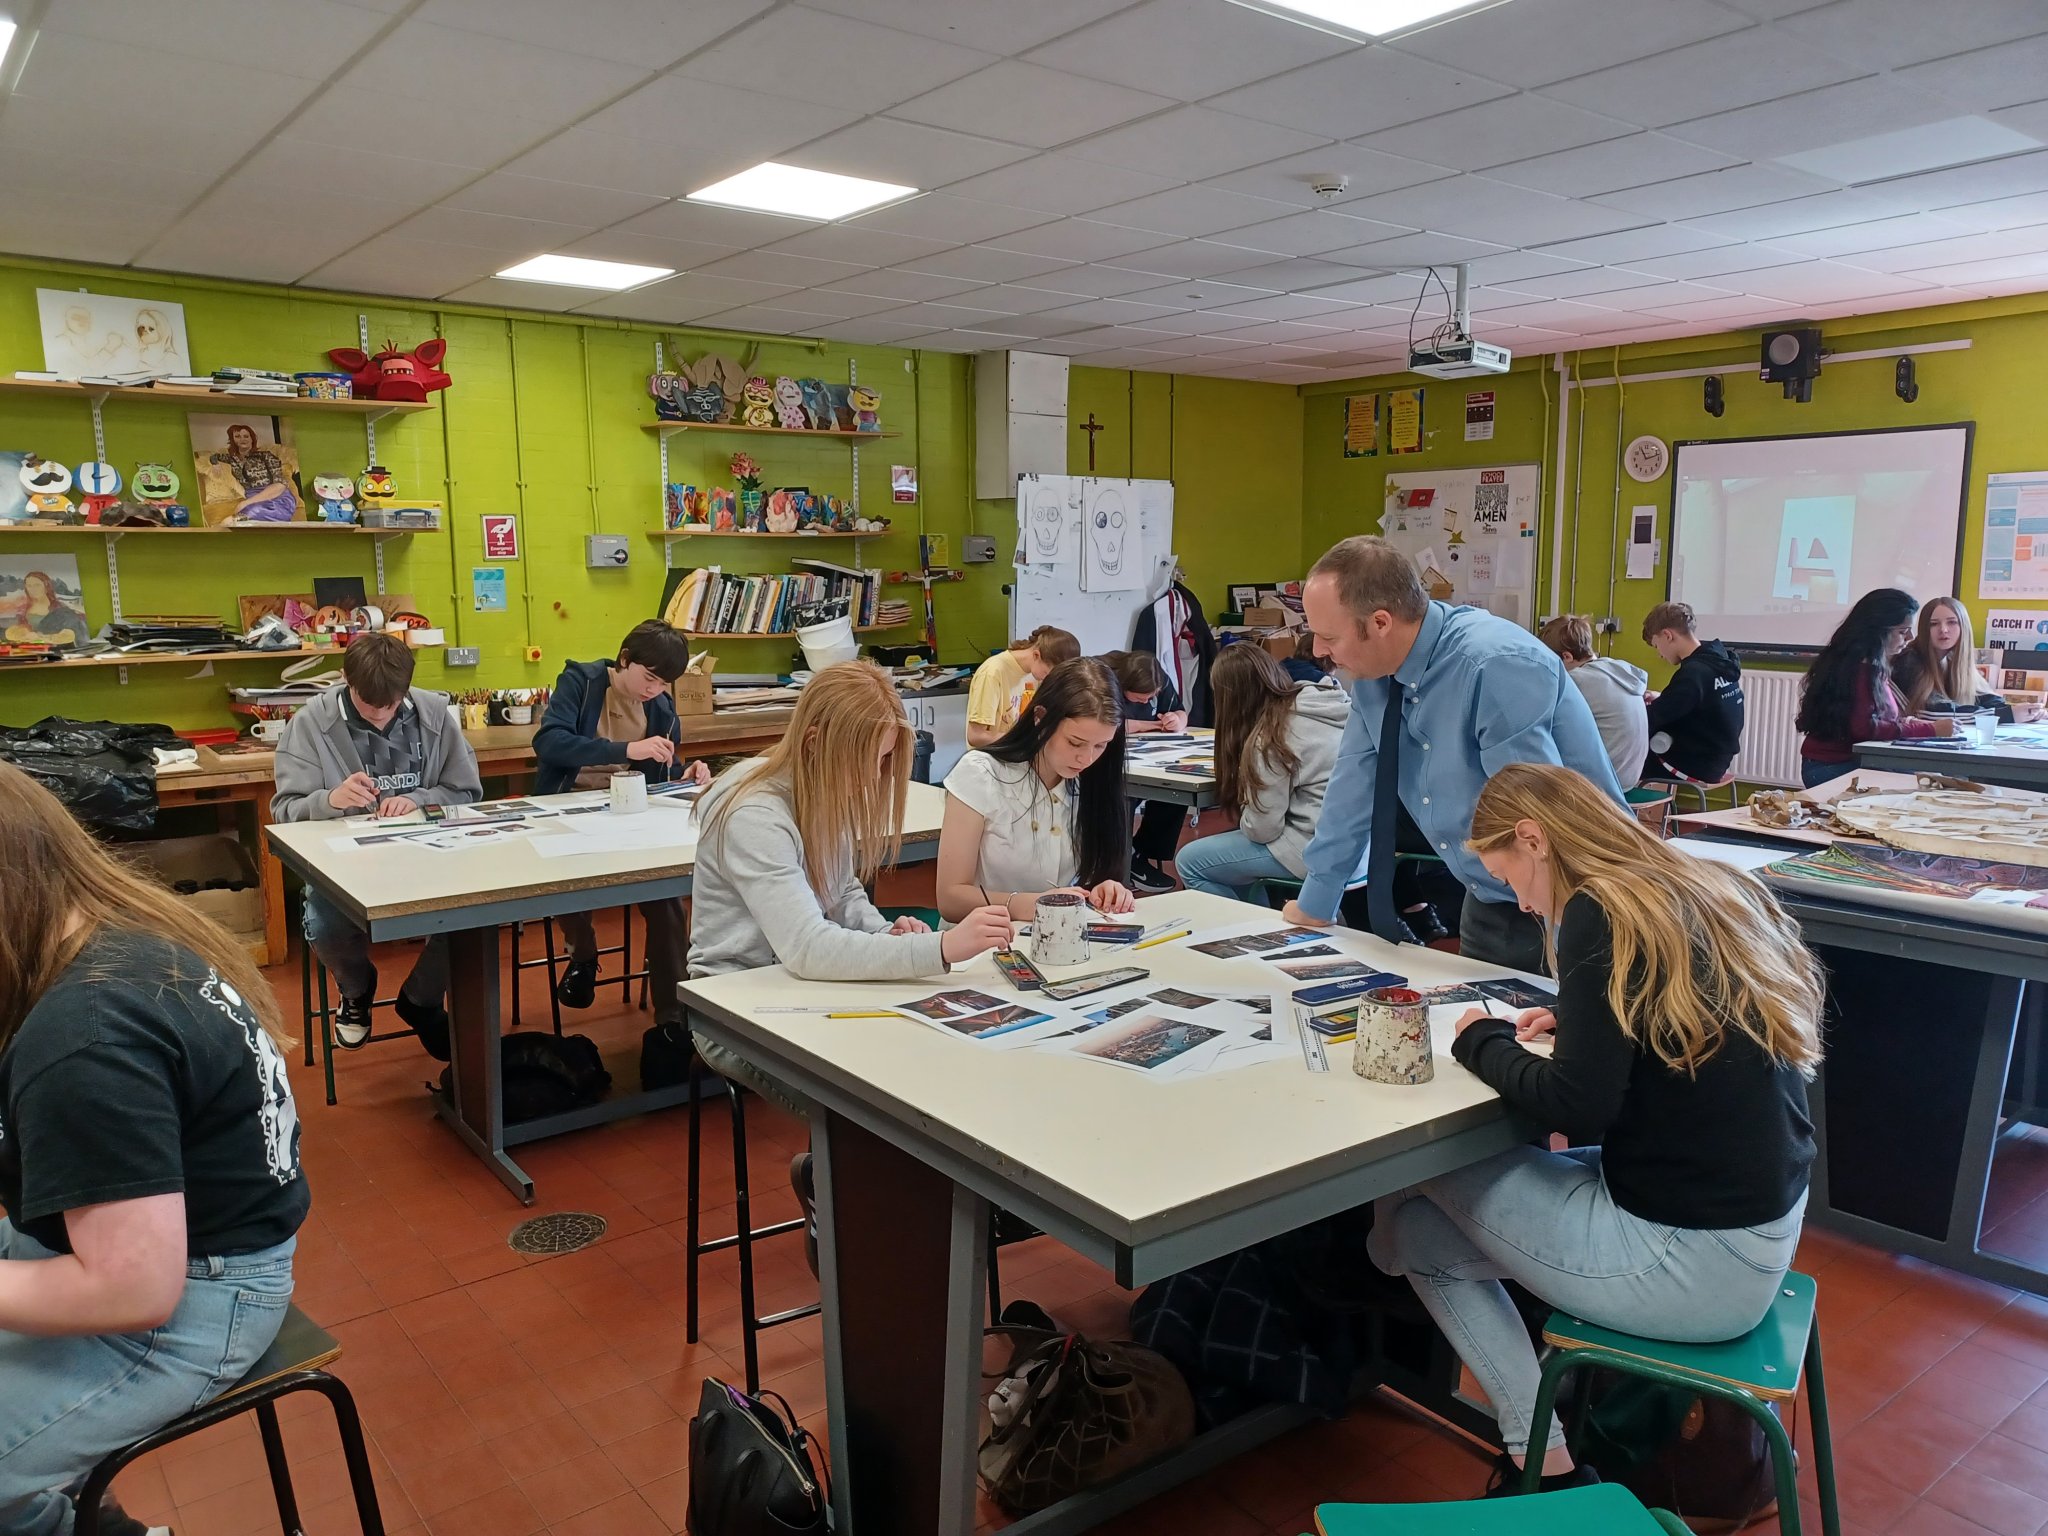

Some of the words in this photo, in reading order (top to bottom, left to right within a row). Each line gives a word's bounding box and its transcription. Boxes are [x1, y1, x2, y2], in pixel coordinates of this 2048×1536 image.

[95, 500, 106, 510] 17
[1474, 511, 1507, 522] AMEN
[1991, 618, 2022, 629] CATCH
[2025, 619, 2035, 629] IT
[1990, 640, 2006, 650] BIN
[2008, 640, 2018, 651] IT
